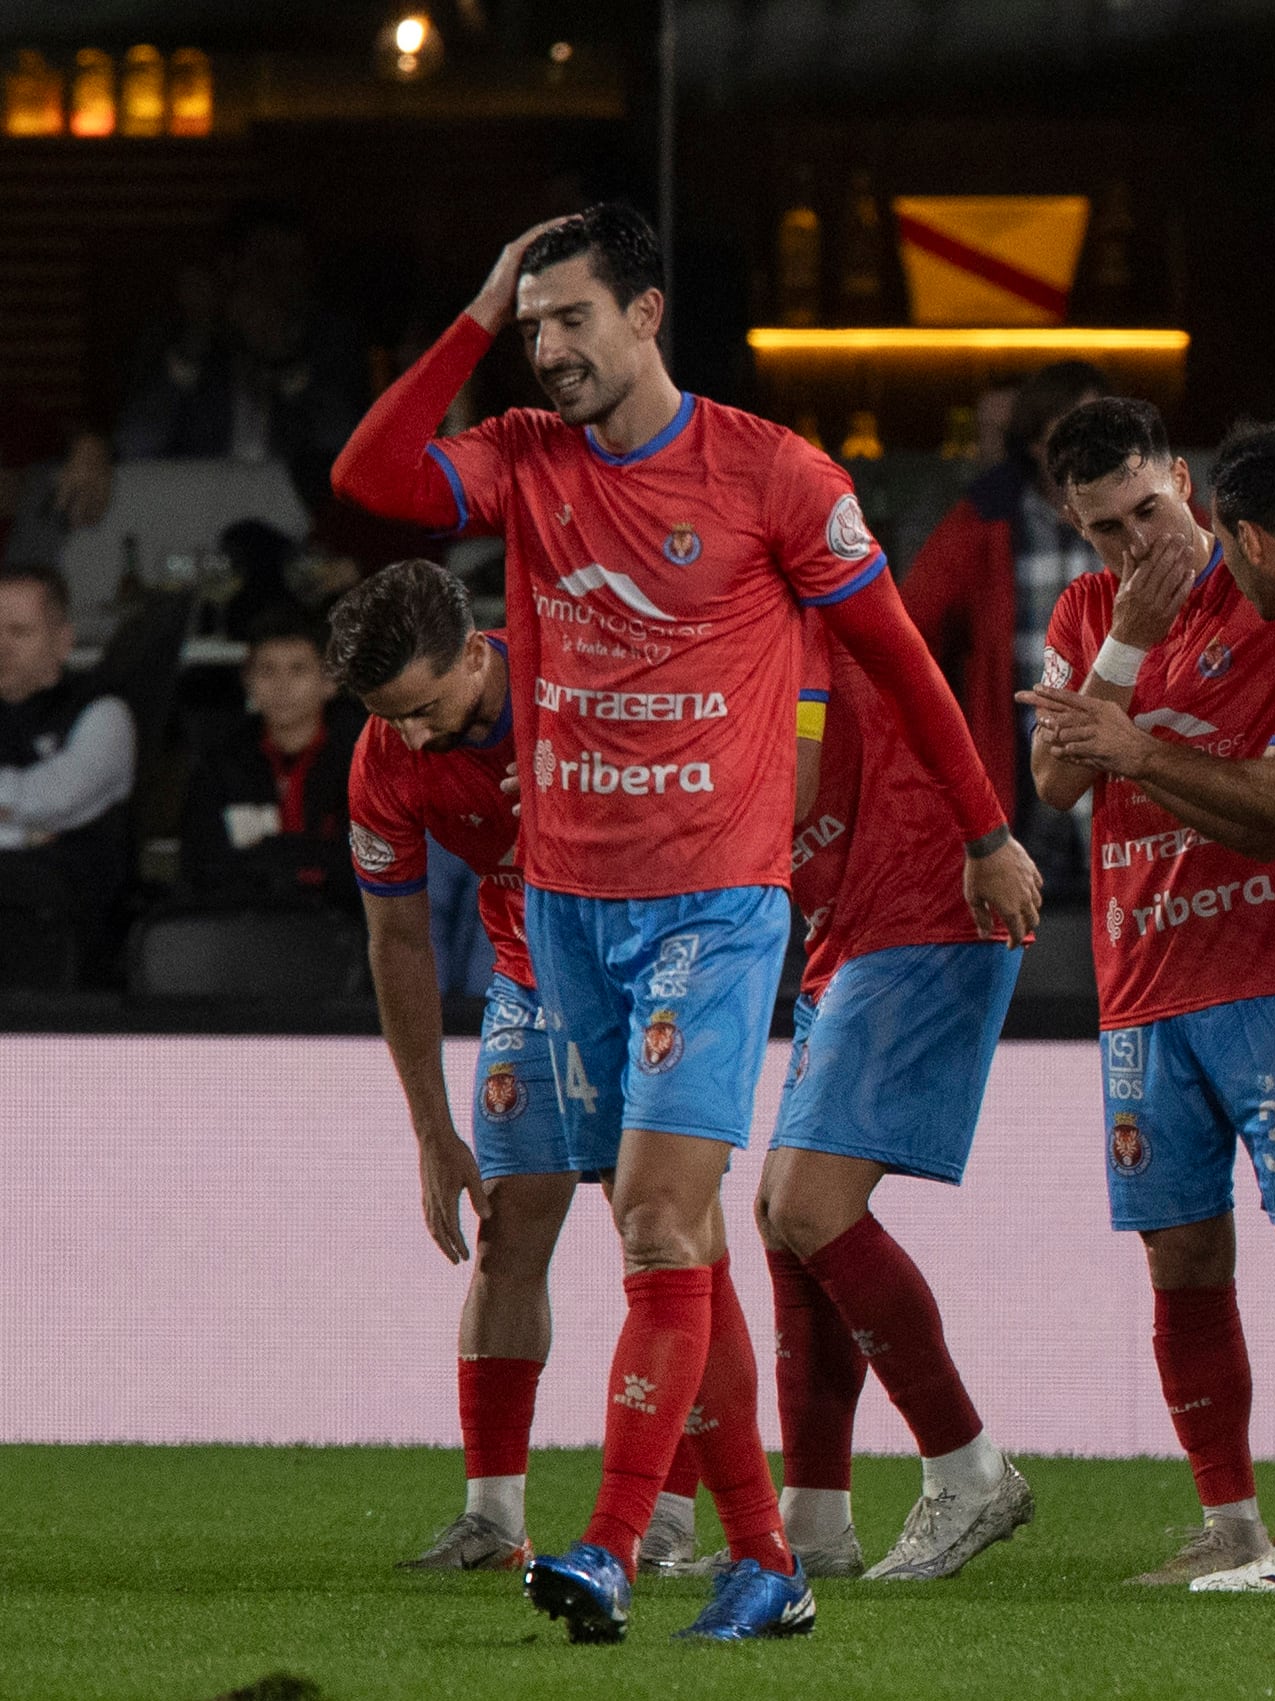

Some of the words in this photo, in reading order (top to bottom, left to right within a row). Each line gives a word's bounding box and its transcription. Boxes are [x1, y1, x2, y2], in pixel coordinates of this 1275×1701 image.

[560, 752, 714, 795] ribera
[1132, 875, 1275, 936] ribera
[1110, 1079, 1143, 1100] ROS
